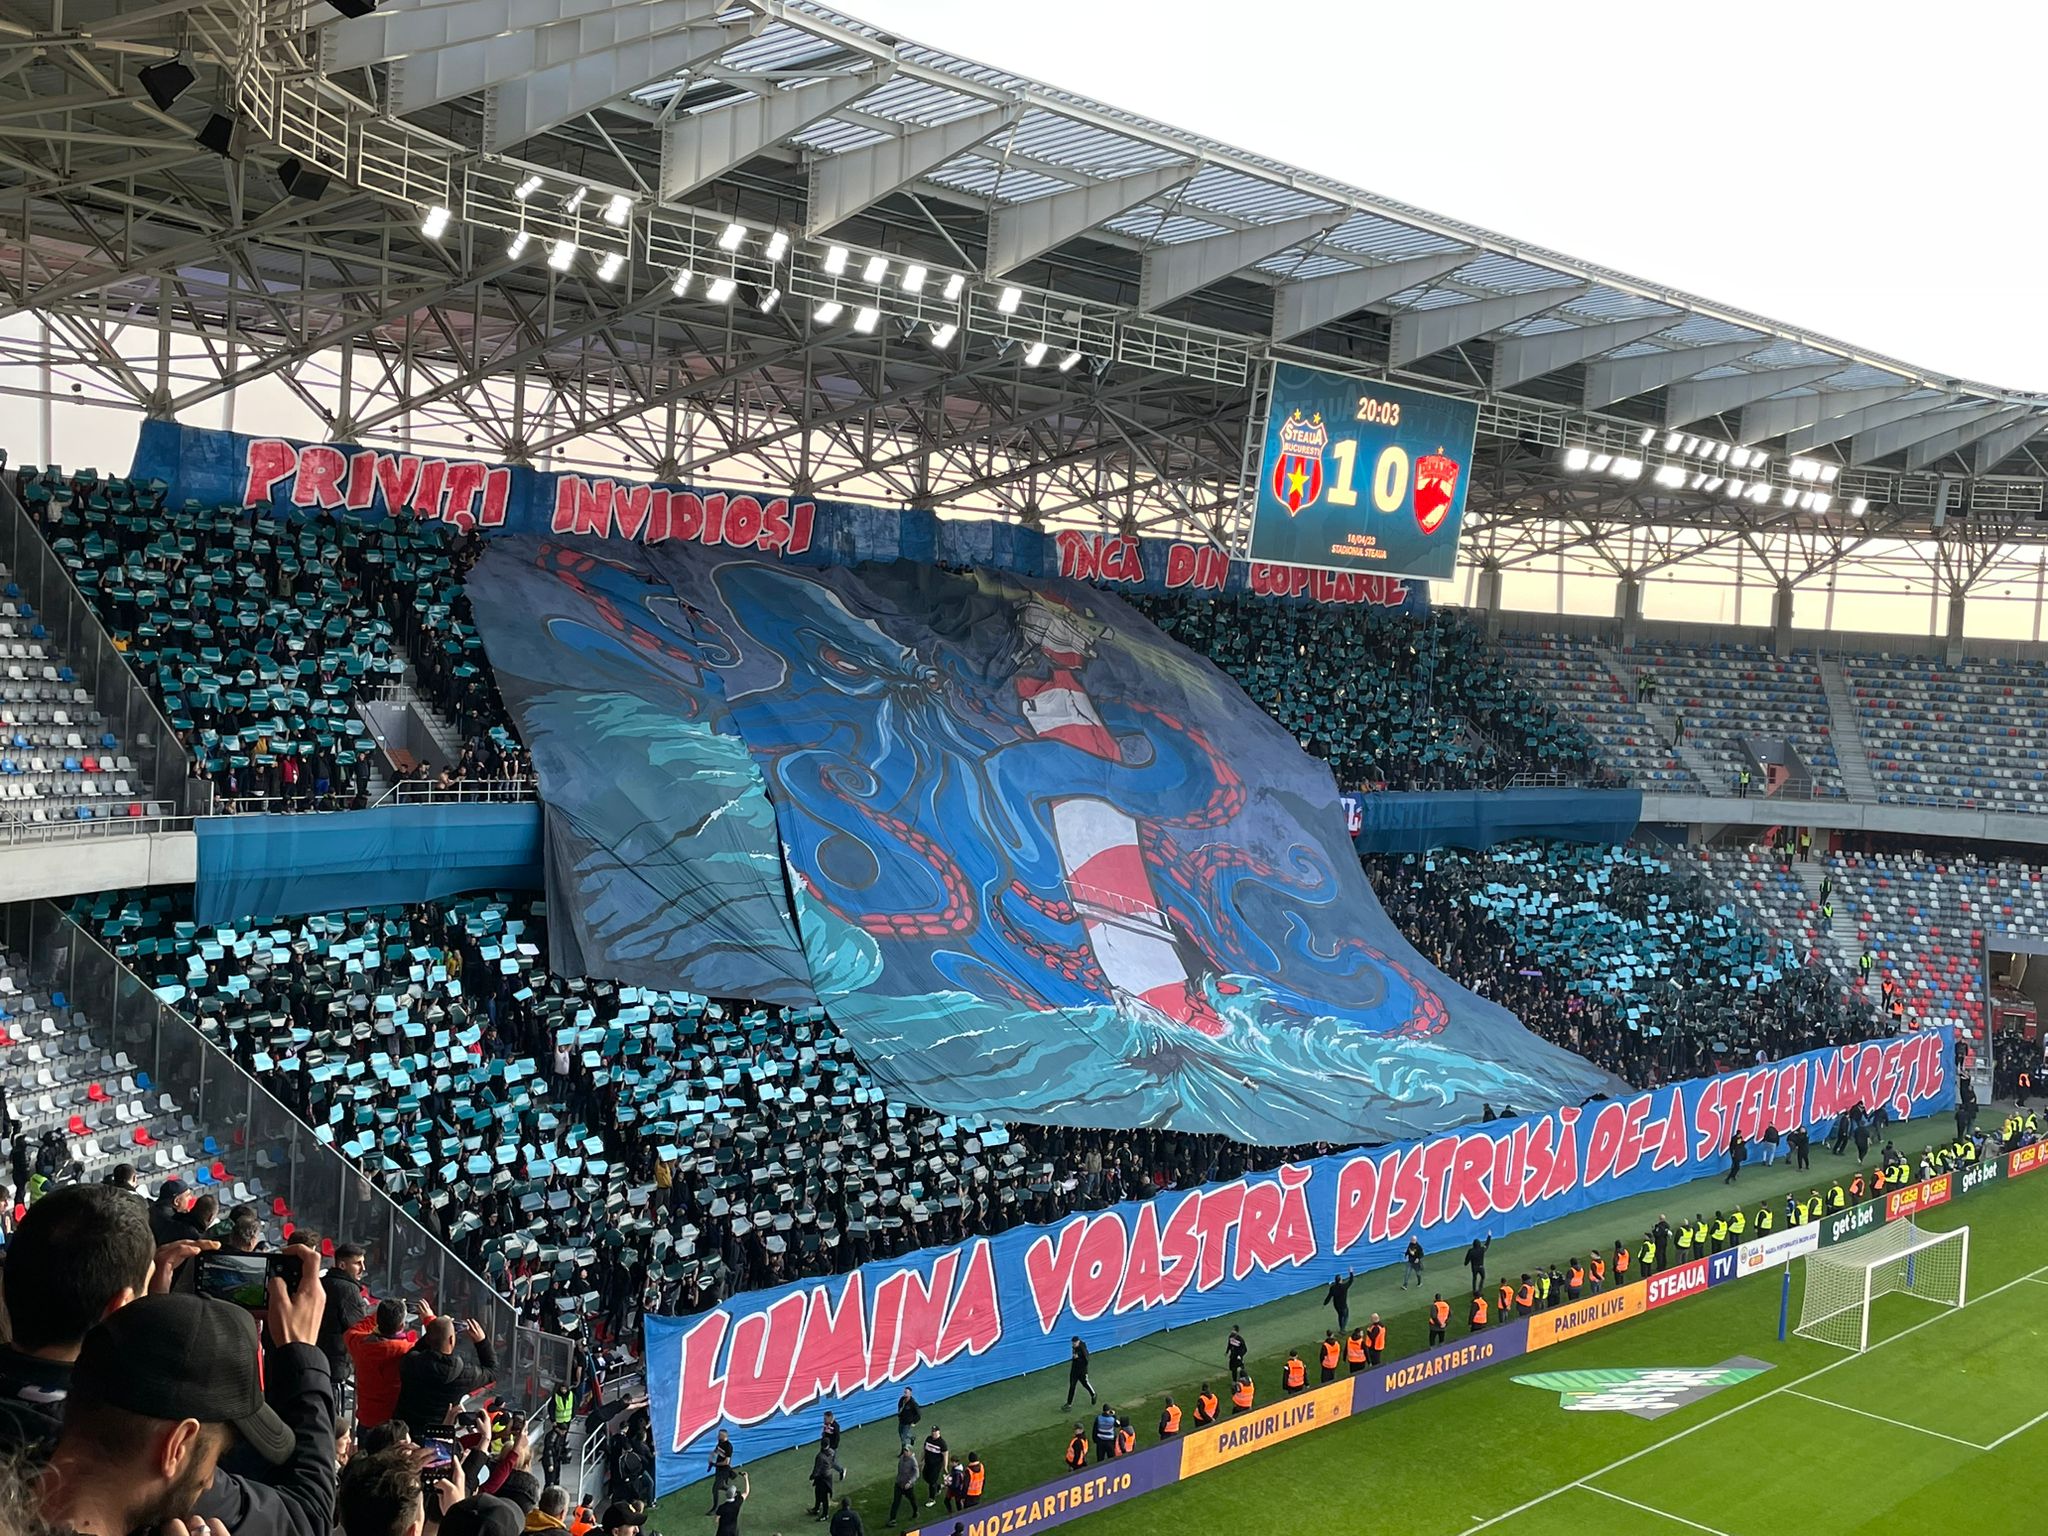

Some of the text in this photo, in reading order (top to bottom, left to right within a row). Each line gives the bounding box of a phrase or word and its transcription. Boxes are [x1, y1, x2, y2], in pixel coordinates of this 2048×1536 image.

[1285, 423, 1322, 446] STEAUA
[1357, 397, 1400, 426] 20:03
[1327, 440, 1409, 513] 1 0
[242, 437, 511, 536] PRIVIȚI
[551, 474, 817, 558] INVIDIOȘI
[1165, 542, 1230, 591] DIN
[1962, 1161, 1998, 1193] get's bet
[673, 1031, 1945, 1454] LUMINA VOASTRĂ DISTRUSĂ DE-A STELEI MĂREȚIE
[1832, 1205, 1874, 1242] get's bet
[1648, 1255, 1734, 1303] STEAUA TV
[1555, 1296, 1625, 1333] PARIURI LIVE
[1385, 1342, 1494, 1392] MOZZARTBET.ro
[1218, 1401, 1316, 1453] PARIURI LIVE
[969, 1473, 1132, 1536] MOZZARTBET.ro
